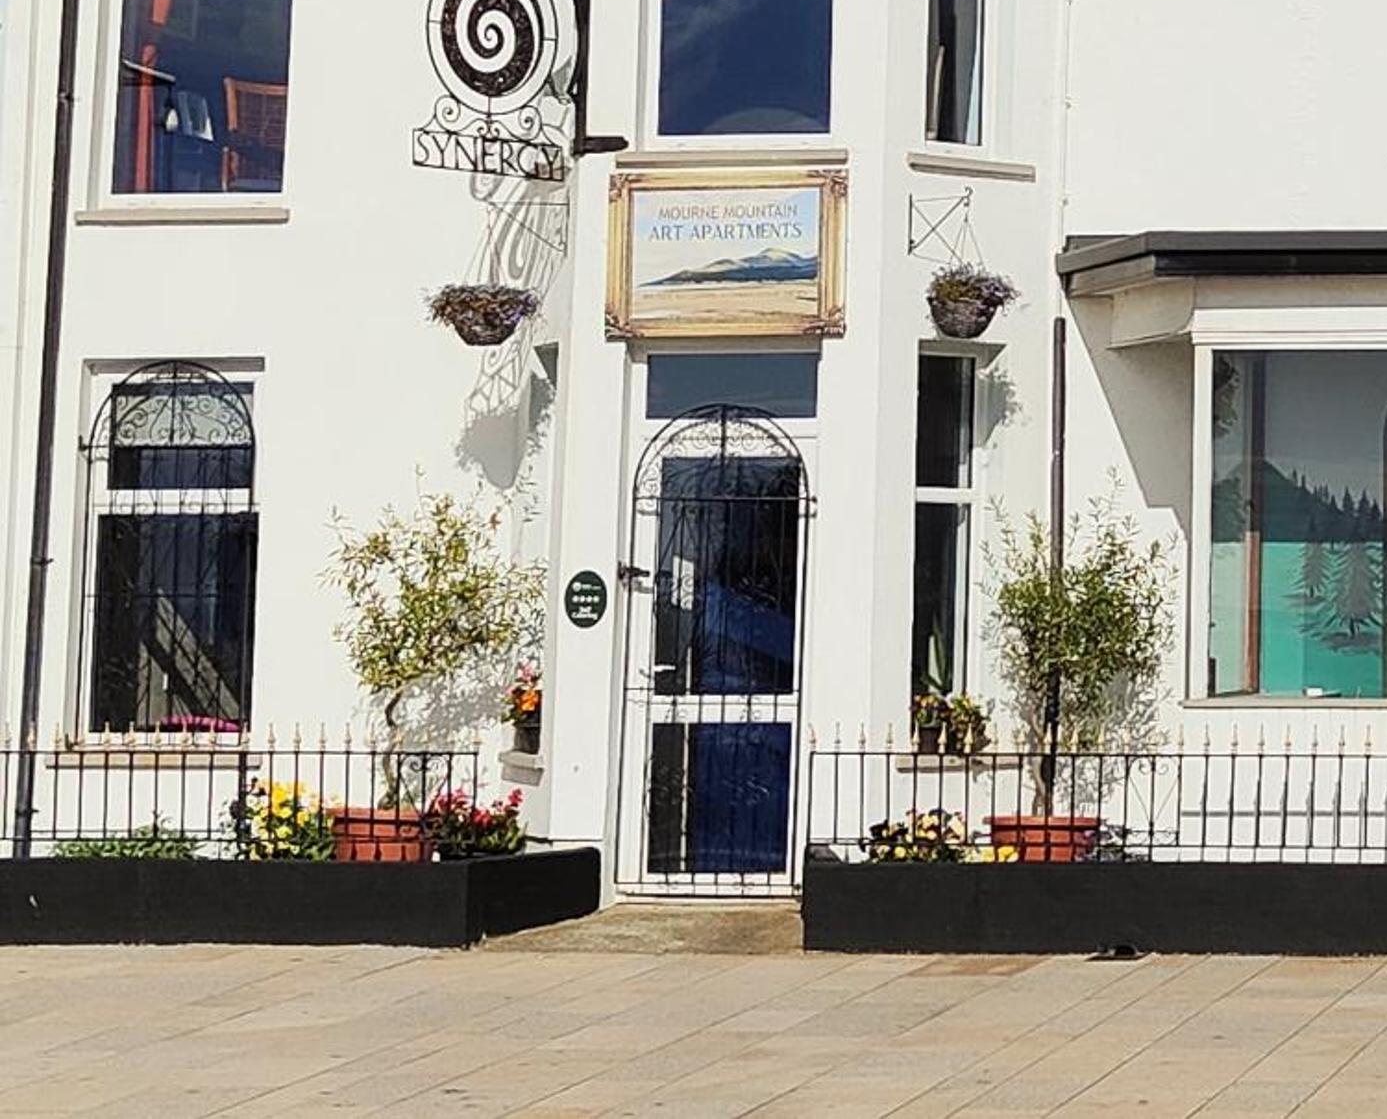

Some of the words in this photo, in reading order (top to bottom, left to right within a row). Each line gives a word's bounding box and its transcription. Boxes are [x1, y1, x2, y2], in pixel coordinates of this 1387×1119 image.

[413, 130, 562, 180] SYNERGY
[658, 205, 720, 220] MOURNE
[722, 203, 798, 219] MOUNTAIN
[650, 224, 684, 241] ART
[690, 222, 803, 241] APARTMENTS
